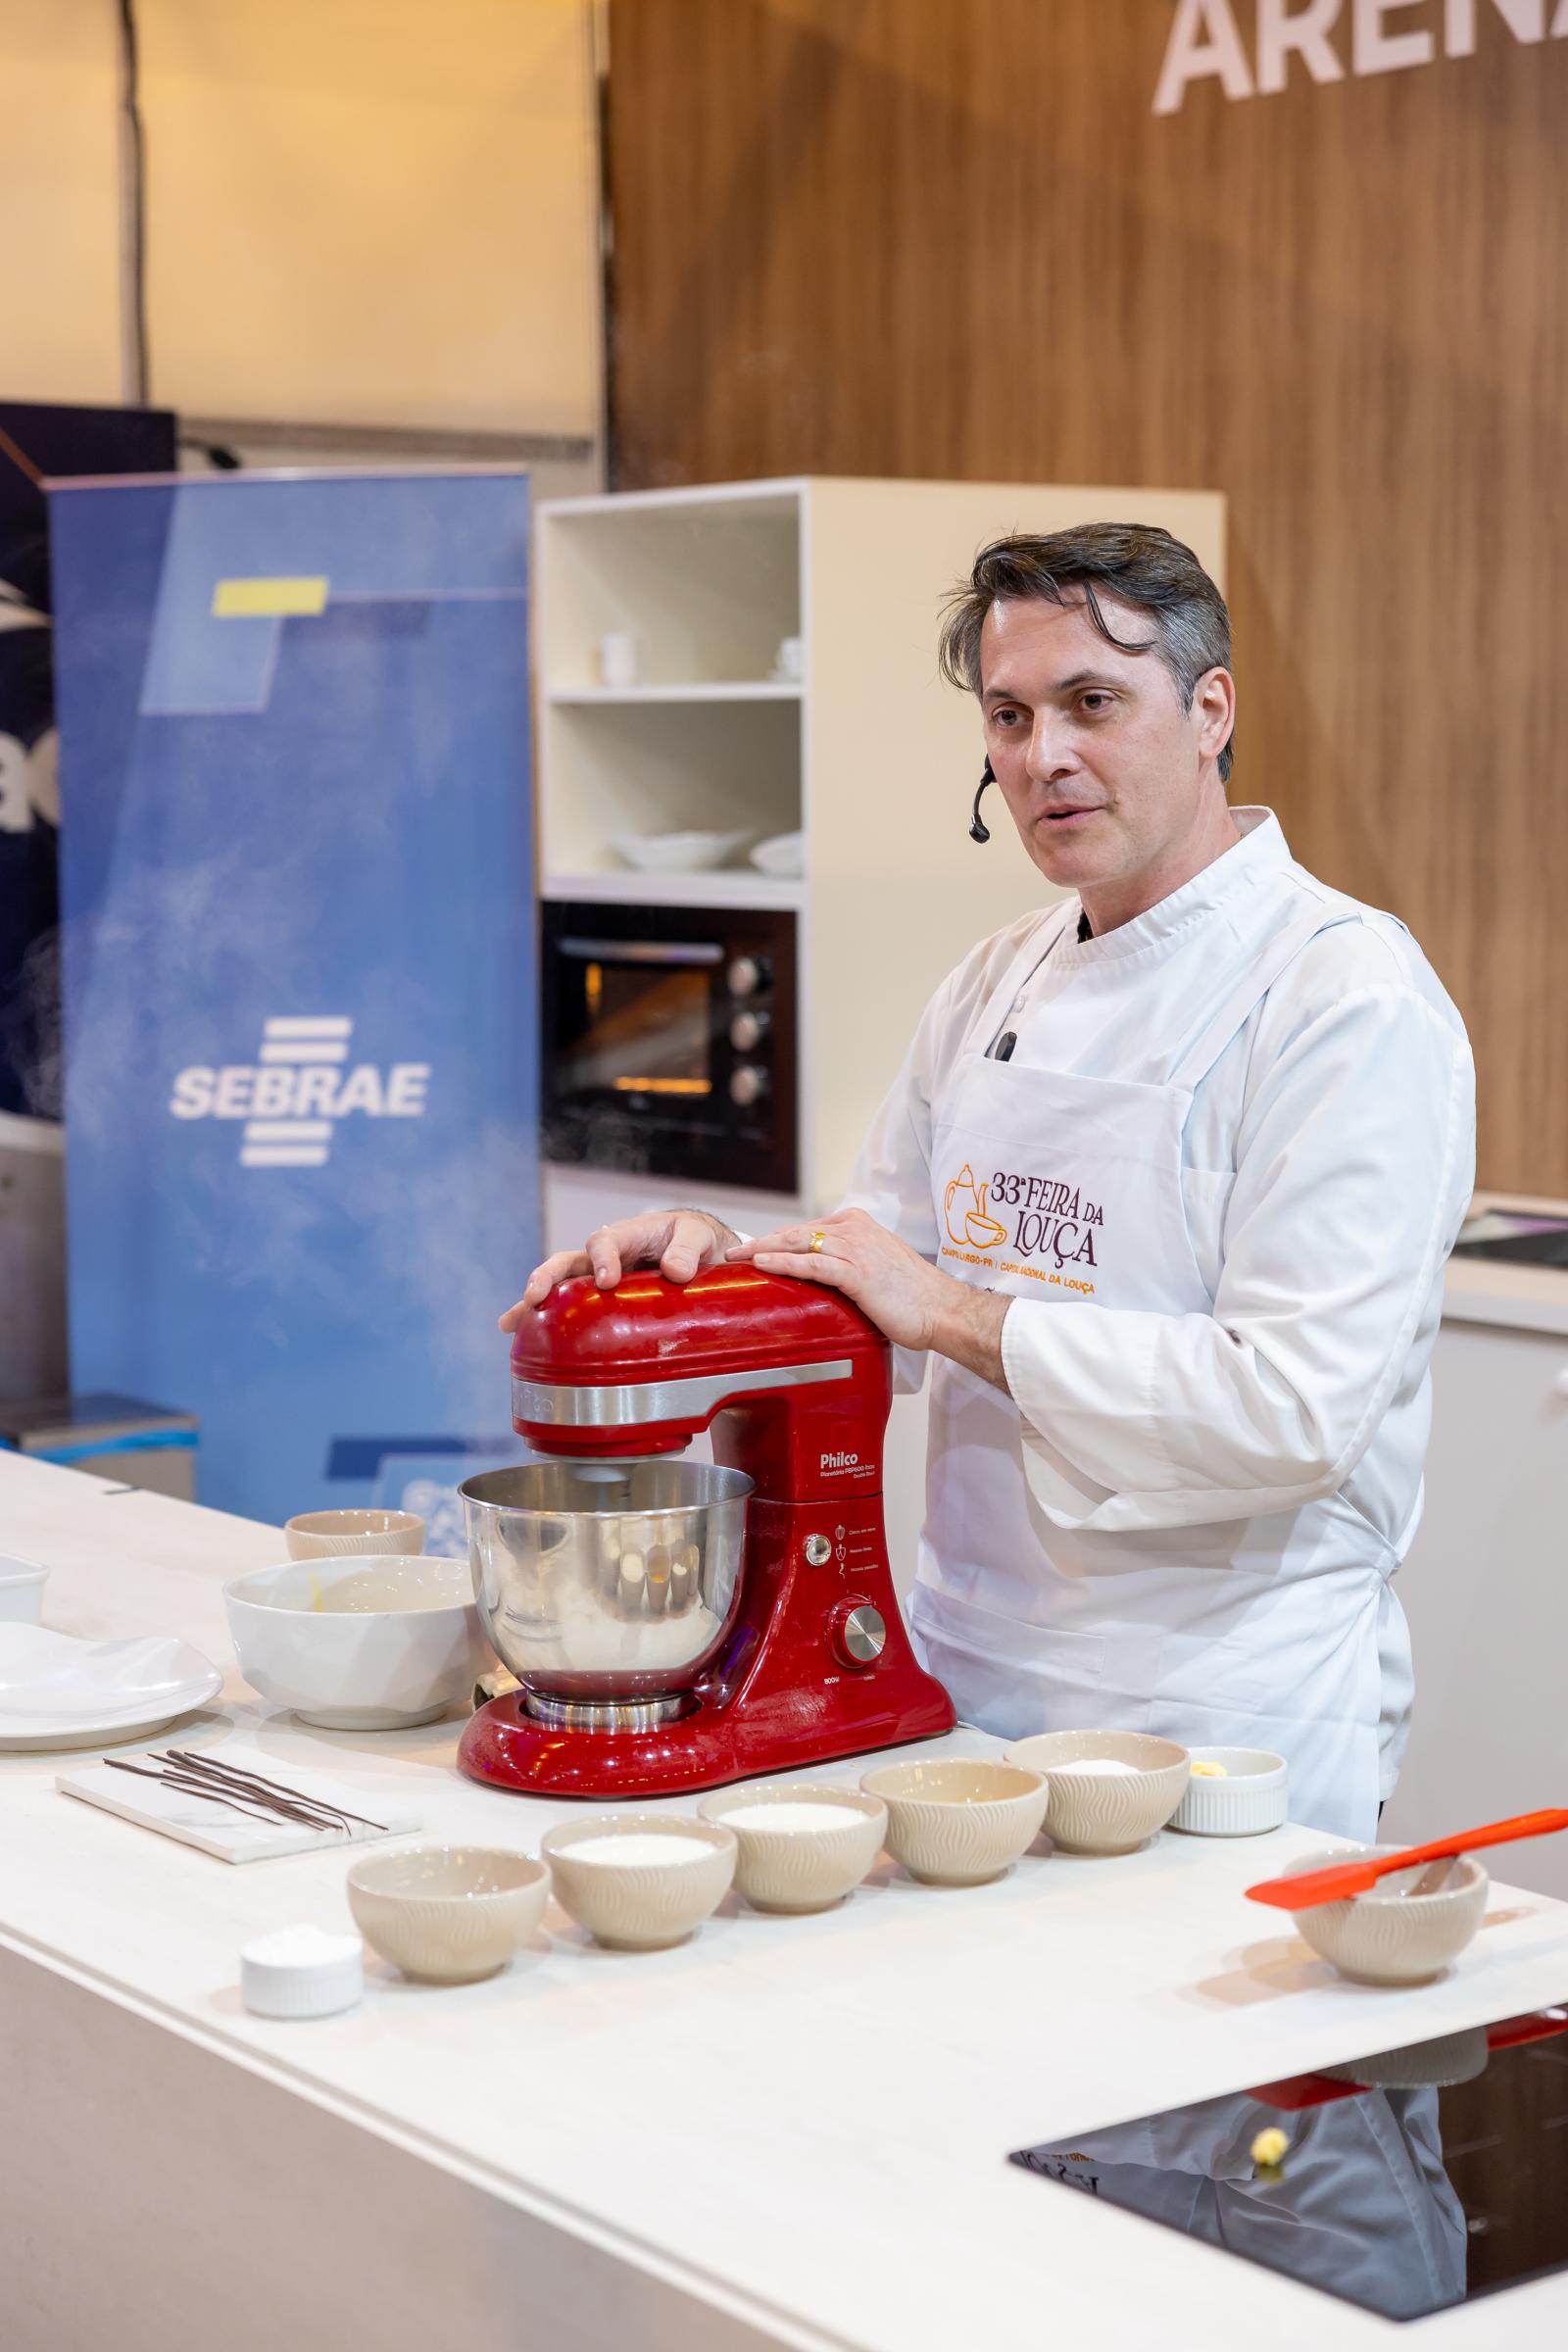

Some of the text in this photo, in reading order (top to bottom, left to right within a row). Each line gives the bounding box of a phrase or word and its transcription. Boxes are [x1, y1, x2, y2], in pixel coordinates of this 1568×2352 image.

[1151, 0, 1568, 118] ARE
[170, 1063, 430, 1120] SEBRAE
[1024, 1176, 1080, 1219] FEIRA
[1082, 1202, 1104, 1226] DA
[1013, 1210, 1098, 1269] LOUÇA
[1049, 1274, 1061, 1286] DA
[1063, 1277, 1096, 1295] LOUÇA
[820, 1451, 858, 1469] Philco
